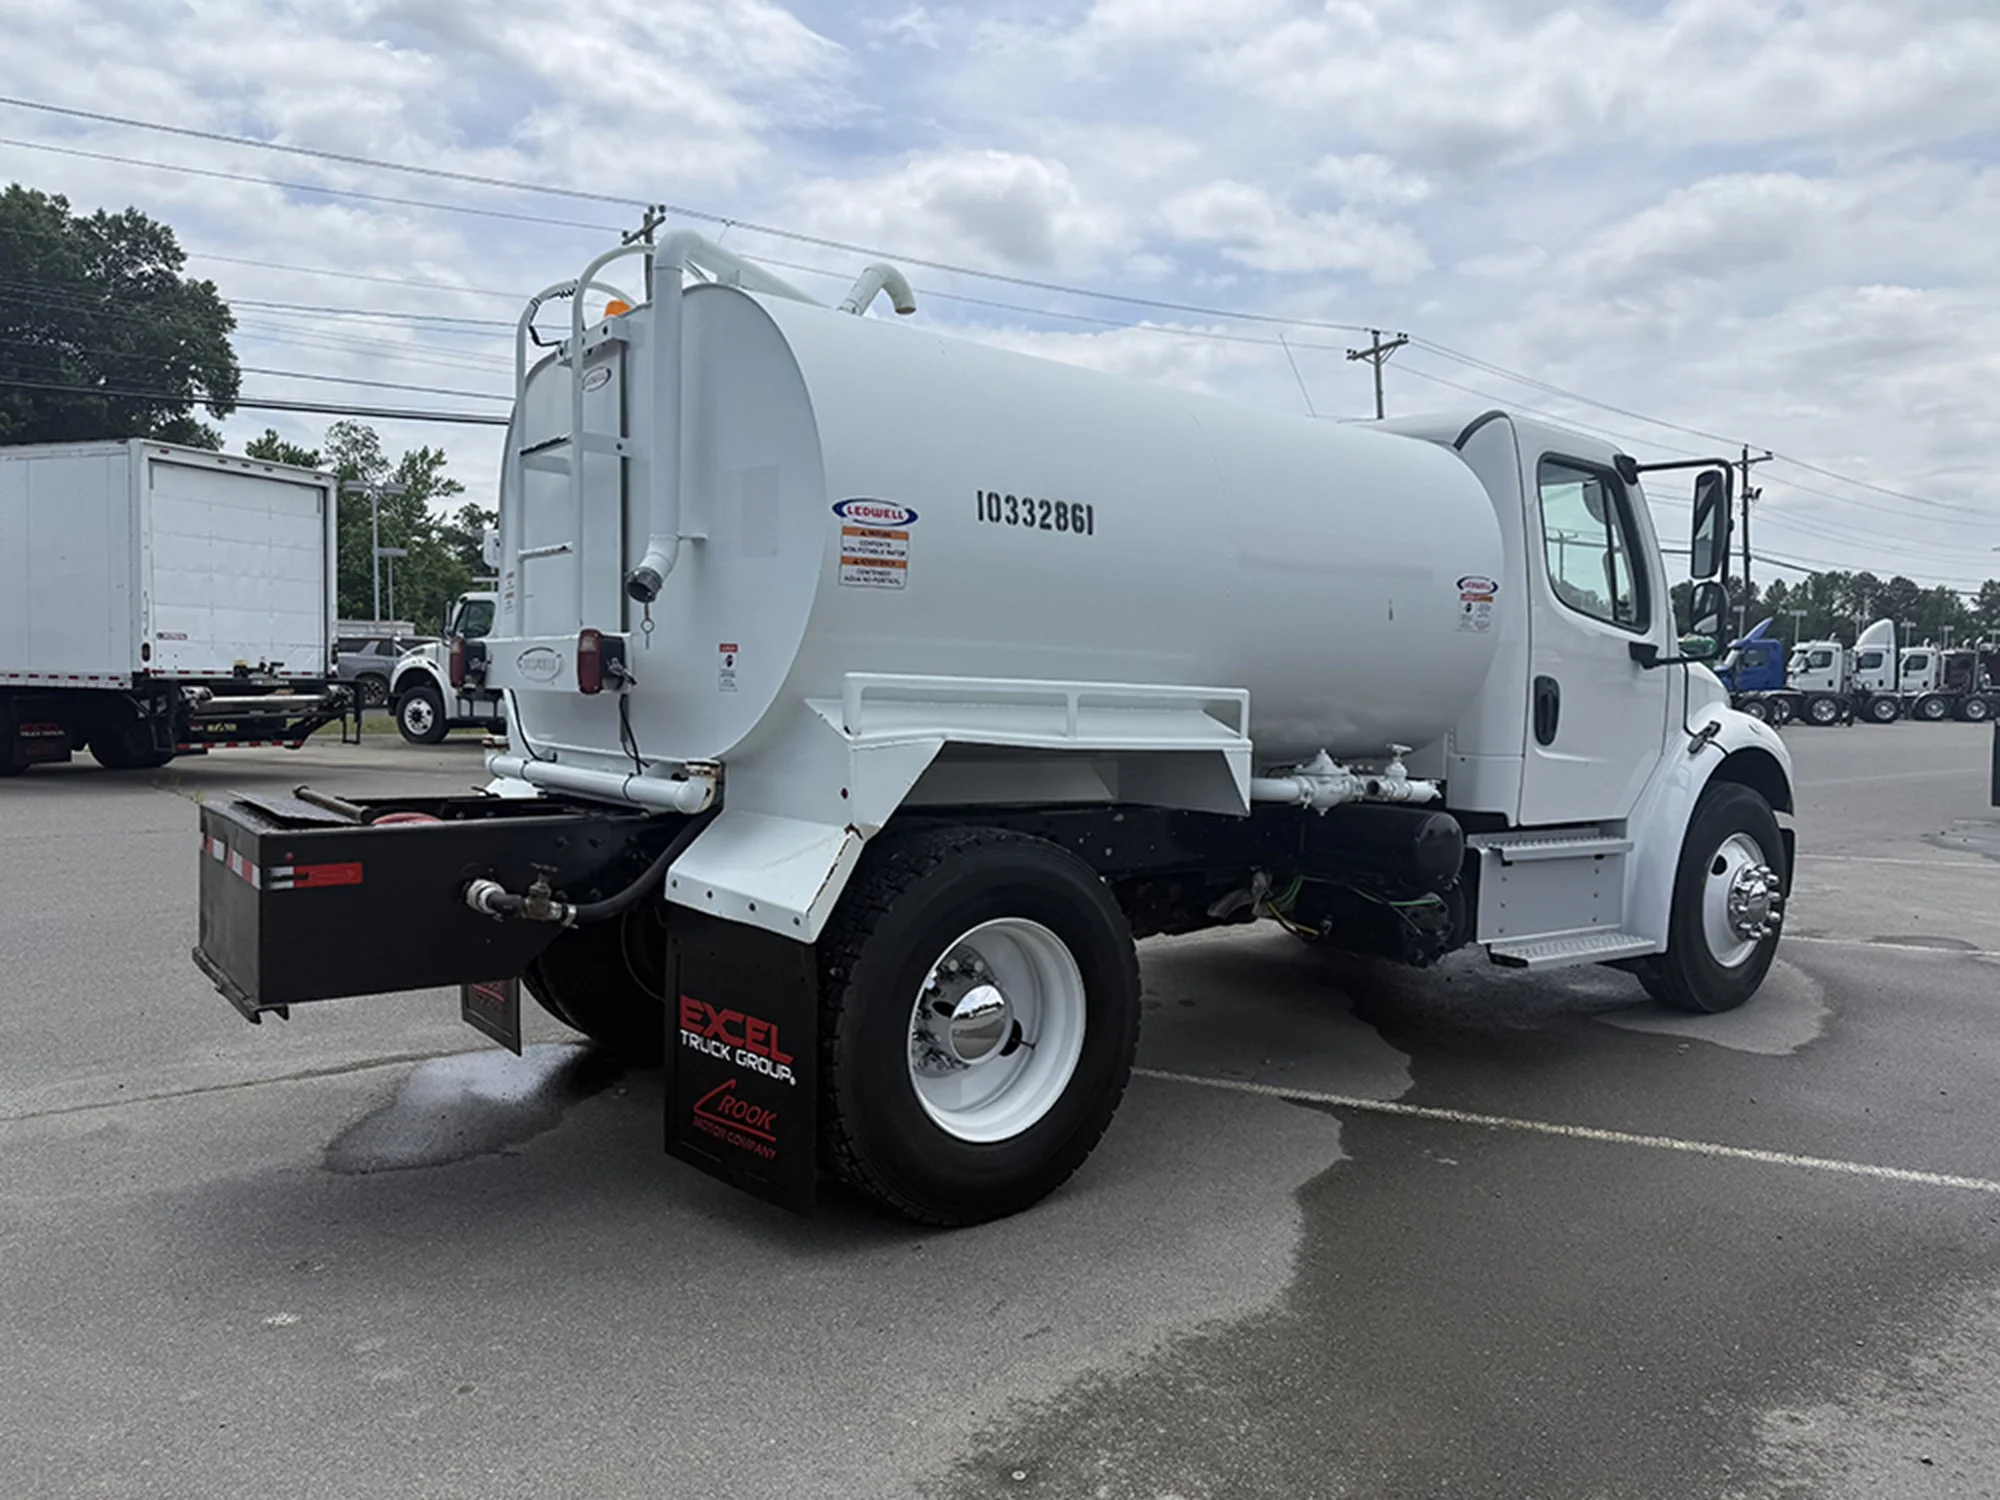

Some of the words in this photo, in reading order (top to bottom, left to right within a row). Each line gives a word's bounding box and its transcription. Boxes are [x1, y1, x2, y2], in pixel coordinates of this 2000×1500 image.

[847, 505, 904, 520] LEDWELL
[976, 490, 1094, 536] 10332861
[680, 994, 794, 1065] EXCEL
[680, 1029, 732, 1062] TRUCK
[727, 1130, 778, 1160] COMPANY
